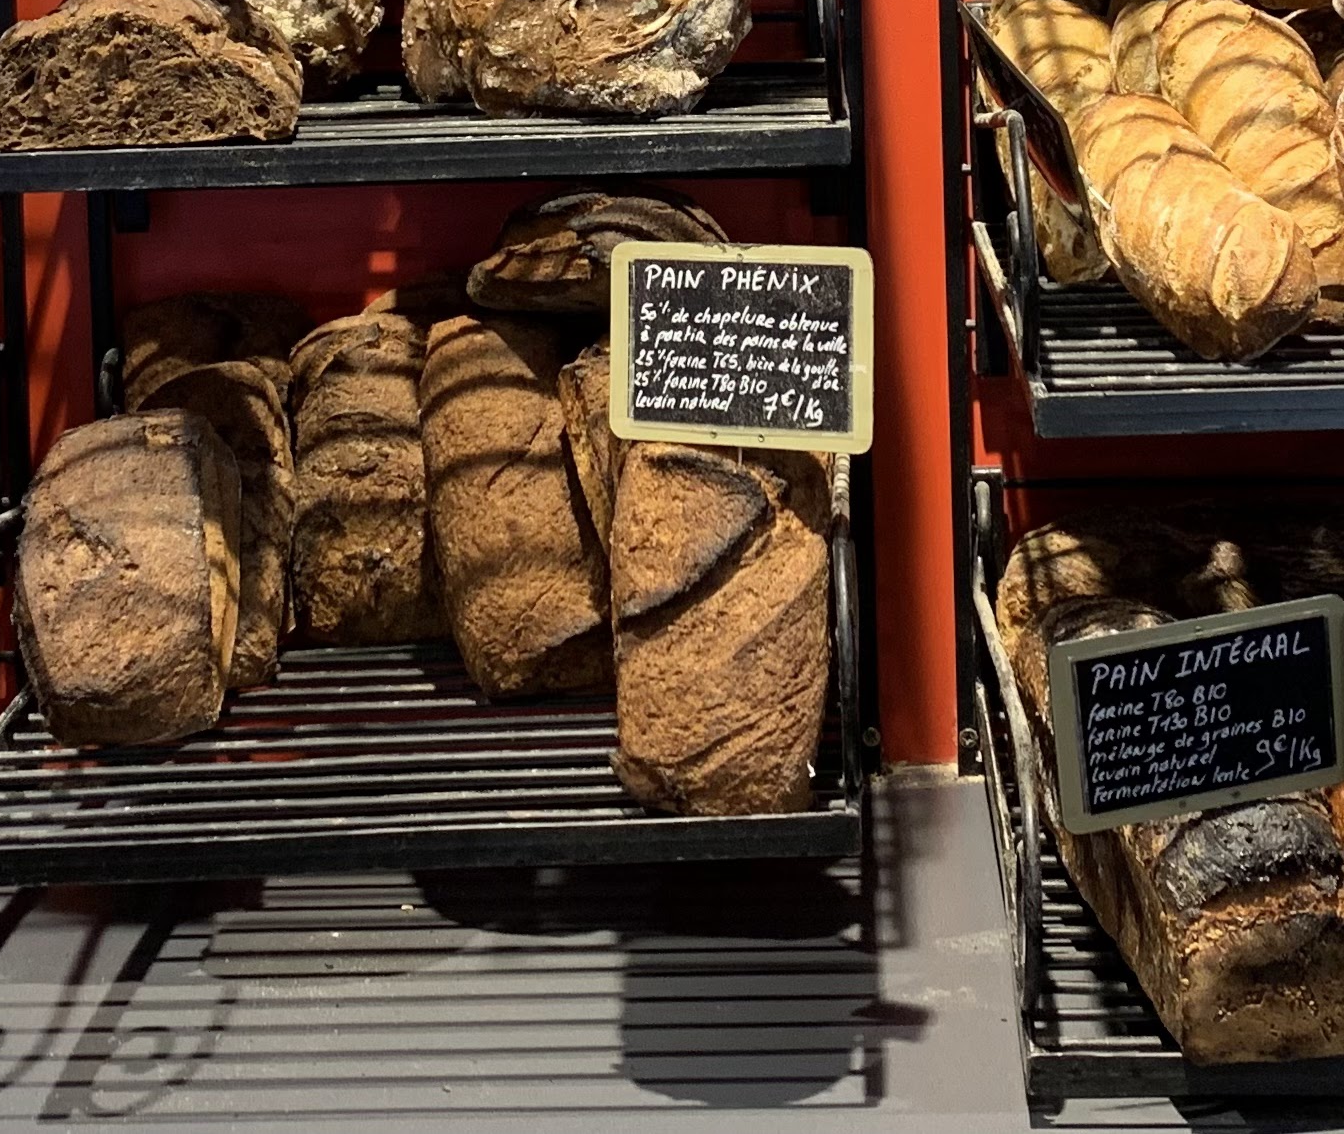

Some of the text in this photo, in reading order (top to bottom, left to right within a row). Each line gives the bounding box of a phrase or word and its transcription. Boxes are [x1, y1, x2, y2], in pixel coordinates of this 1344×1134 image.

[644, 264, 820, 294] PAIN PHÉNIX
[672, 307, 690, 324] de
[693, 305, 775, 329] chapelure
[779, 316, 839, 333] obtenue
[655, 325, 707, 348] partir
[713, 331, 736, 347] des
[740, 336, 781, 351] pains
[782, 334, 798, 351] de
[802, 336, 814, 352] la
[663, 351, 707, 372] farine
[663, 371, 708, 393] farine
[711, 373, 736, 392] T80
[739, 377, 767, 395] BIO
[679, 393, 734, 412] naturel
[1091, 631, 1310, 695] PAIN INTÉGRAL
[1088, 682, 1228, 730] farine T80 BIO
[1088, 704, 1232, 752] farine T130 BIO
[1174, 731, 1194, 750] de
[1200, 719, 1263, 750] graines
[1272, 707, 1307, 729] BIO
[1148, 744, 1218, 774] naturel
